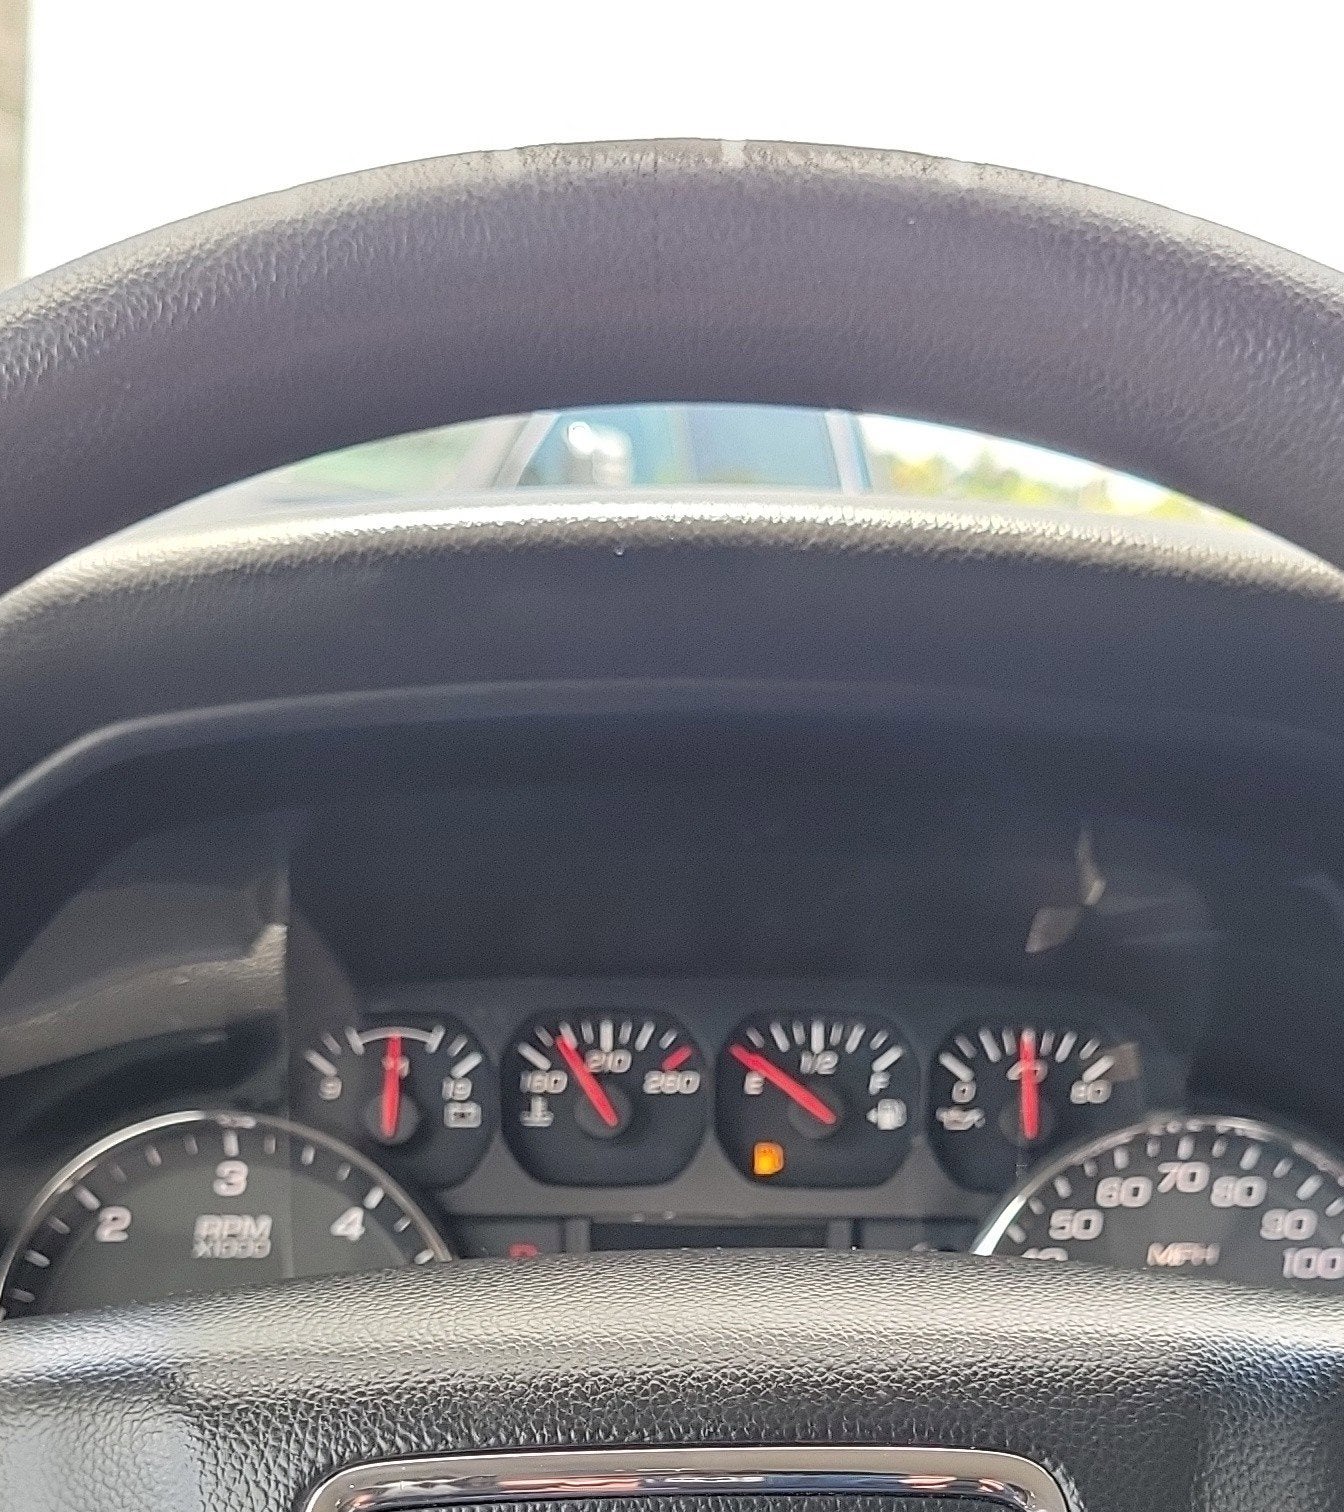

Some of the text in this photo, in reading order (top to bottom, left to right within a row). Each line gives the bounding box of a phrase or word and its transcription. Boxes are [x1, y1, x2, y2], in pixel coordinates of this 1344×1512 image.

[800, 1050, 838, 1075] 1/2
[744, 1070, 764, 1095] E
[868, 1070, 890, 1095] F
[213, 1160, 248, 1197] 3
[1096, 1176, 1153, 1208] 60
[1157, 1161, 1210, 1193] 70
[1210, 1176, 1267, 1207] 80
[96, 1206, 132, 1242] 2
[194, 1214, 273, 1240] RPM
[330, 1206, 365, 1241] 4
[1049, 1208, 1104, 1240] 50
[1260, 1208, 1318, 1240] 90
[1147, 1242, 1221, 1266] MPH
